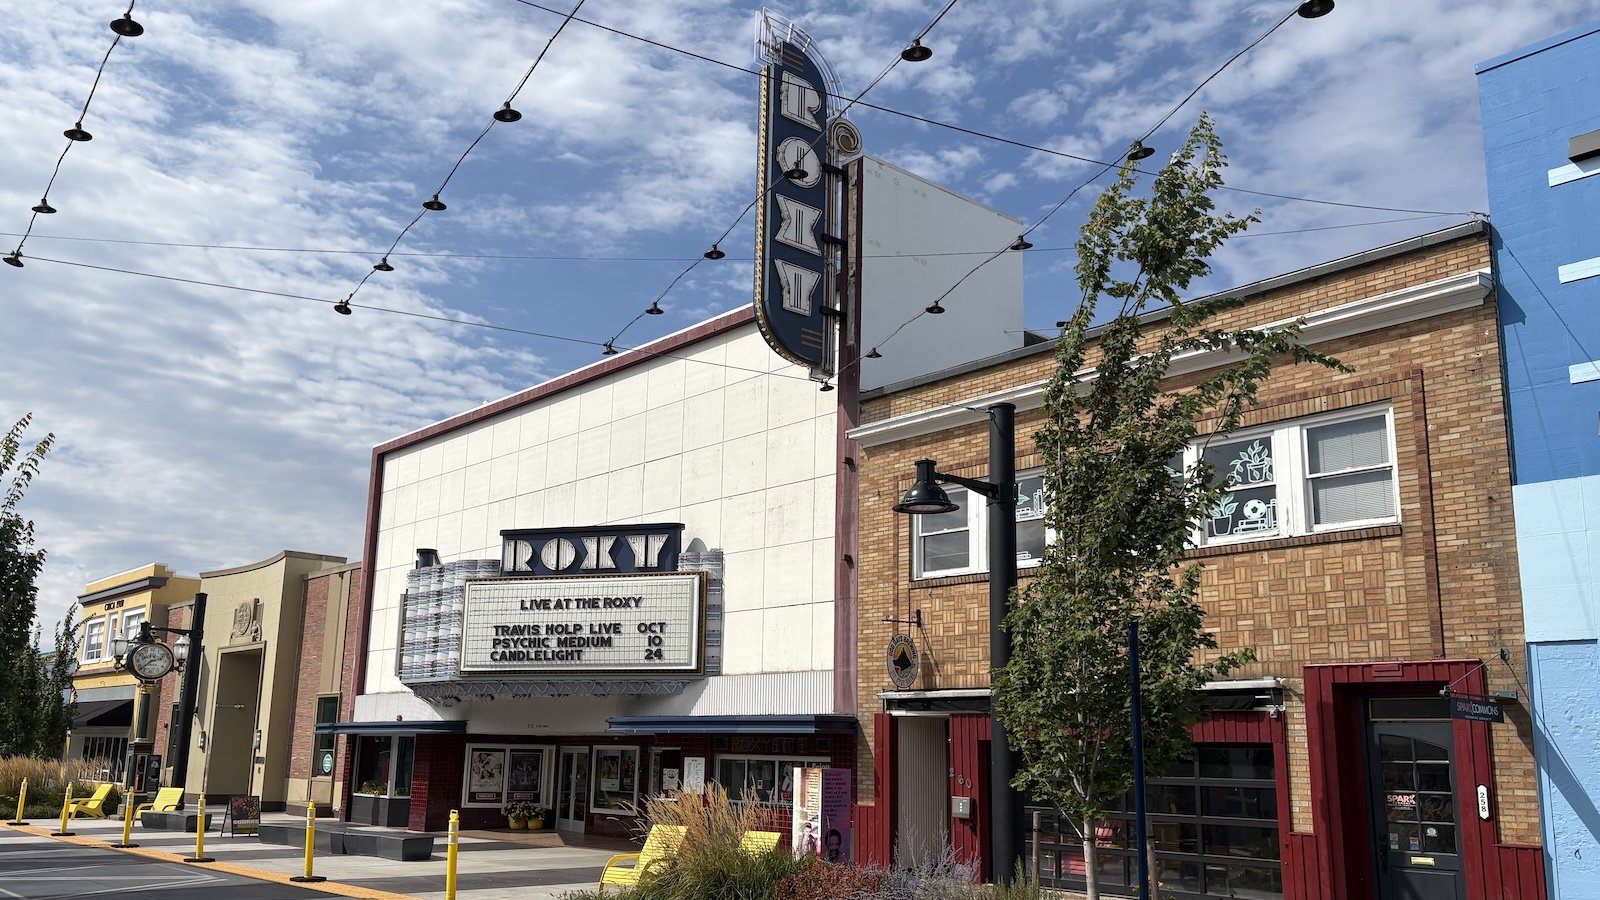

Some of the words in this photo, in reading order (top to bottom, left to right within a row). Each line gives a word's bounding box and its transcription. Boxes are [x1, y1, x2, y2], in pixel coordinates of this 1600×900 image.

[775, 70, 823, 317] ROXY
[503, 534, 670, 572] ROXY
[520, 598, 552, 611] LIVE
[553, 598, 572, 610] AT
[574, 597, 601, 609] THE
[603, 596, 642, 609] ROXY
[493, 624, 541, 636] TRAVIS
[545, 623, 583, 635] HOLP
[589, 622, 622, 634] LIVE
[637, 622, 666, 634] OCT
[492, 637, 550, 649] PSYCHIC
[557, 636, 612, 648] MEDIUM
[648, 635, 663, 647] 10
[490, 649, 583, 662] CANDLELIGHT
[644, 648, 663, 660] 24
[949, 767, 972, 789] 260
[1386, 793, 1416, 804] SPARK
[1479, 792, 1487, 813] 258
